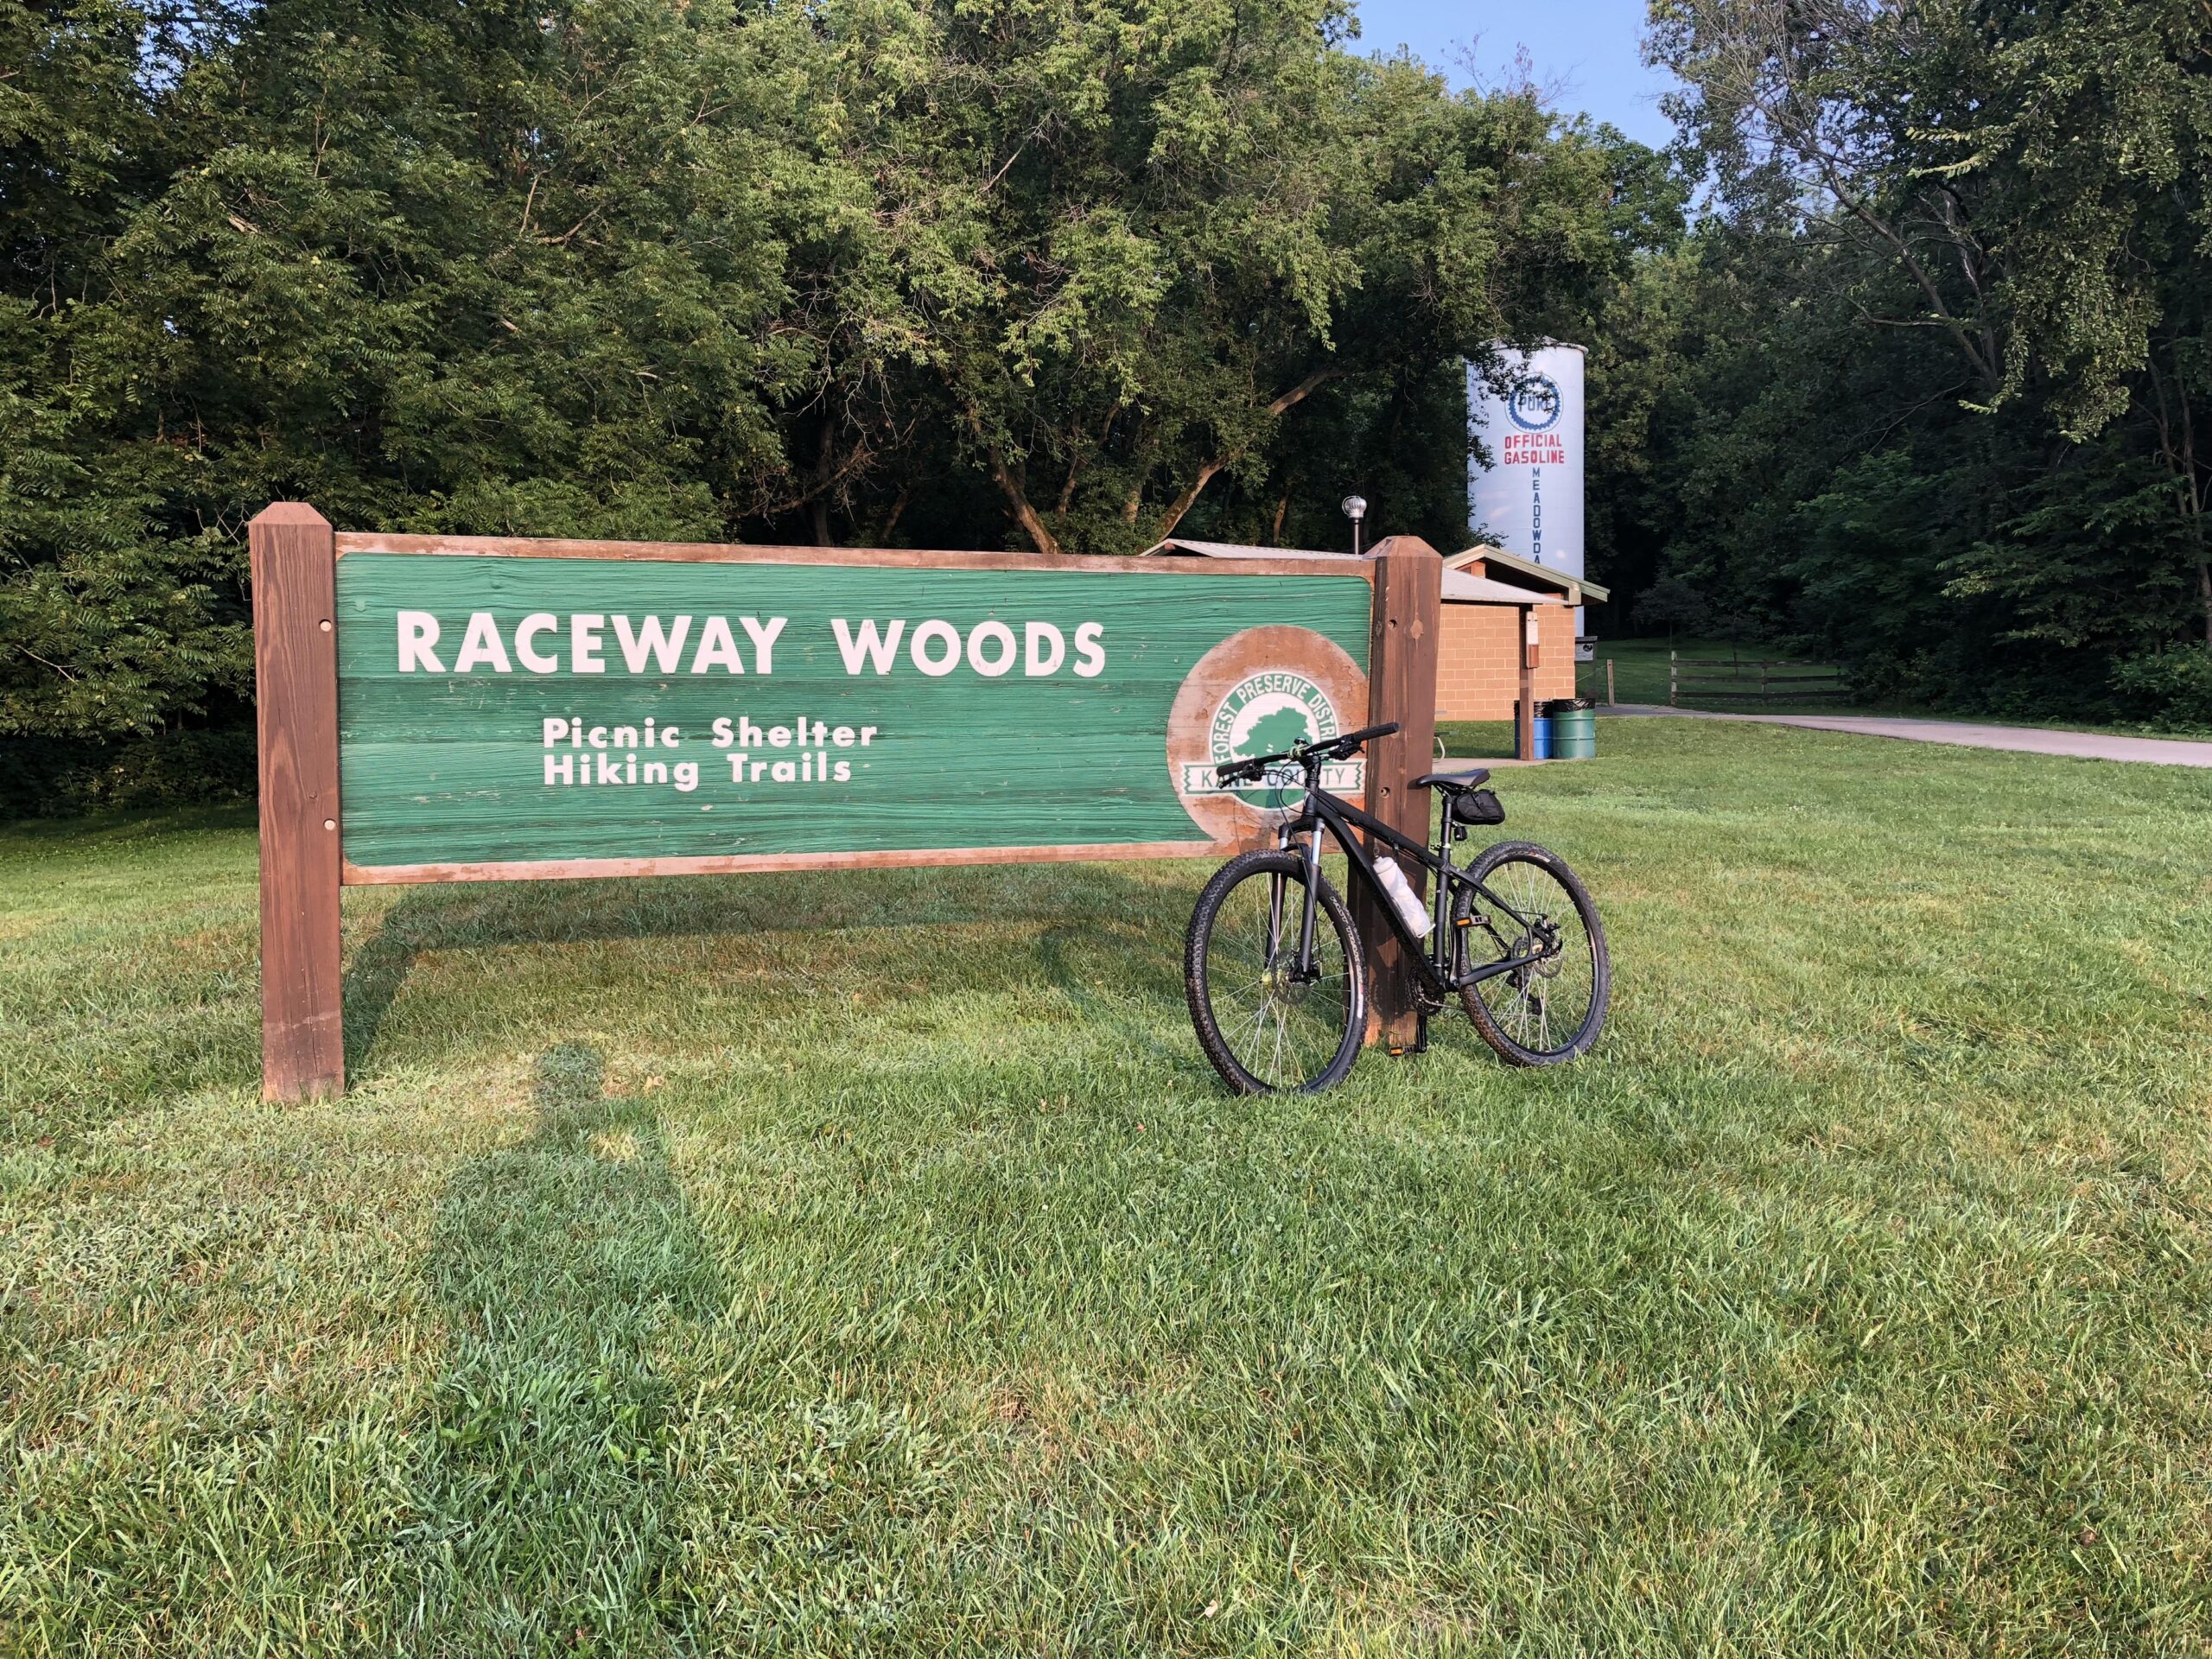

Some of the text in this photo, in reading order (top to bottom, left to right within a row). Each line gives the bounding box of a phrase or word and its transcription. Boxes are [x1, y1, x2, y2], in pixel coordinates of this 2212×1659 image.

[1504, 434, 1562, 449] OFFICIAL
[1504, 449, 1565, 465] GASOLINE
[1532, 467, 1542, 564] MEADOWDA
[397, 610, 1107, 678] RACEWAY WOODS
[543, 716, 878, 749] Picnic Shelter
[1213, 675, 1337, 764] FOREST PRESERVE DISTRI
[543, 751, 852, 792] Hiking Trails
[1267, 767, 1345, 787] COUTY
